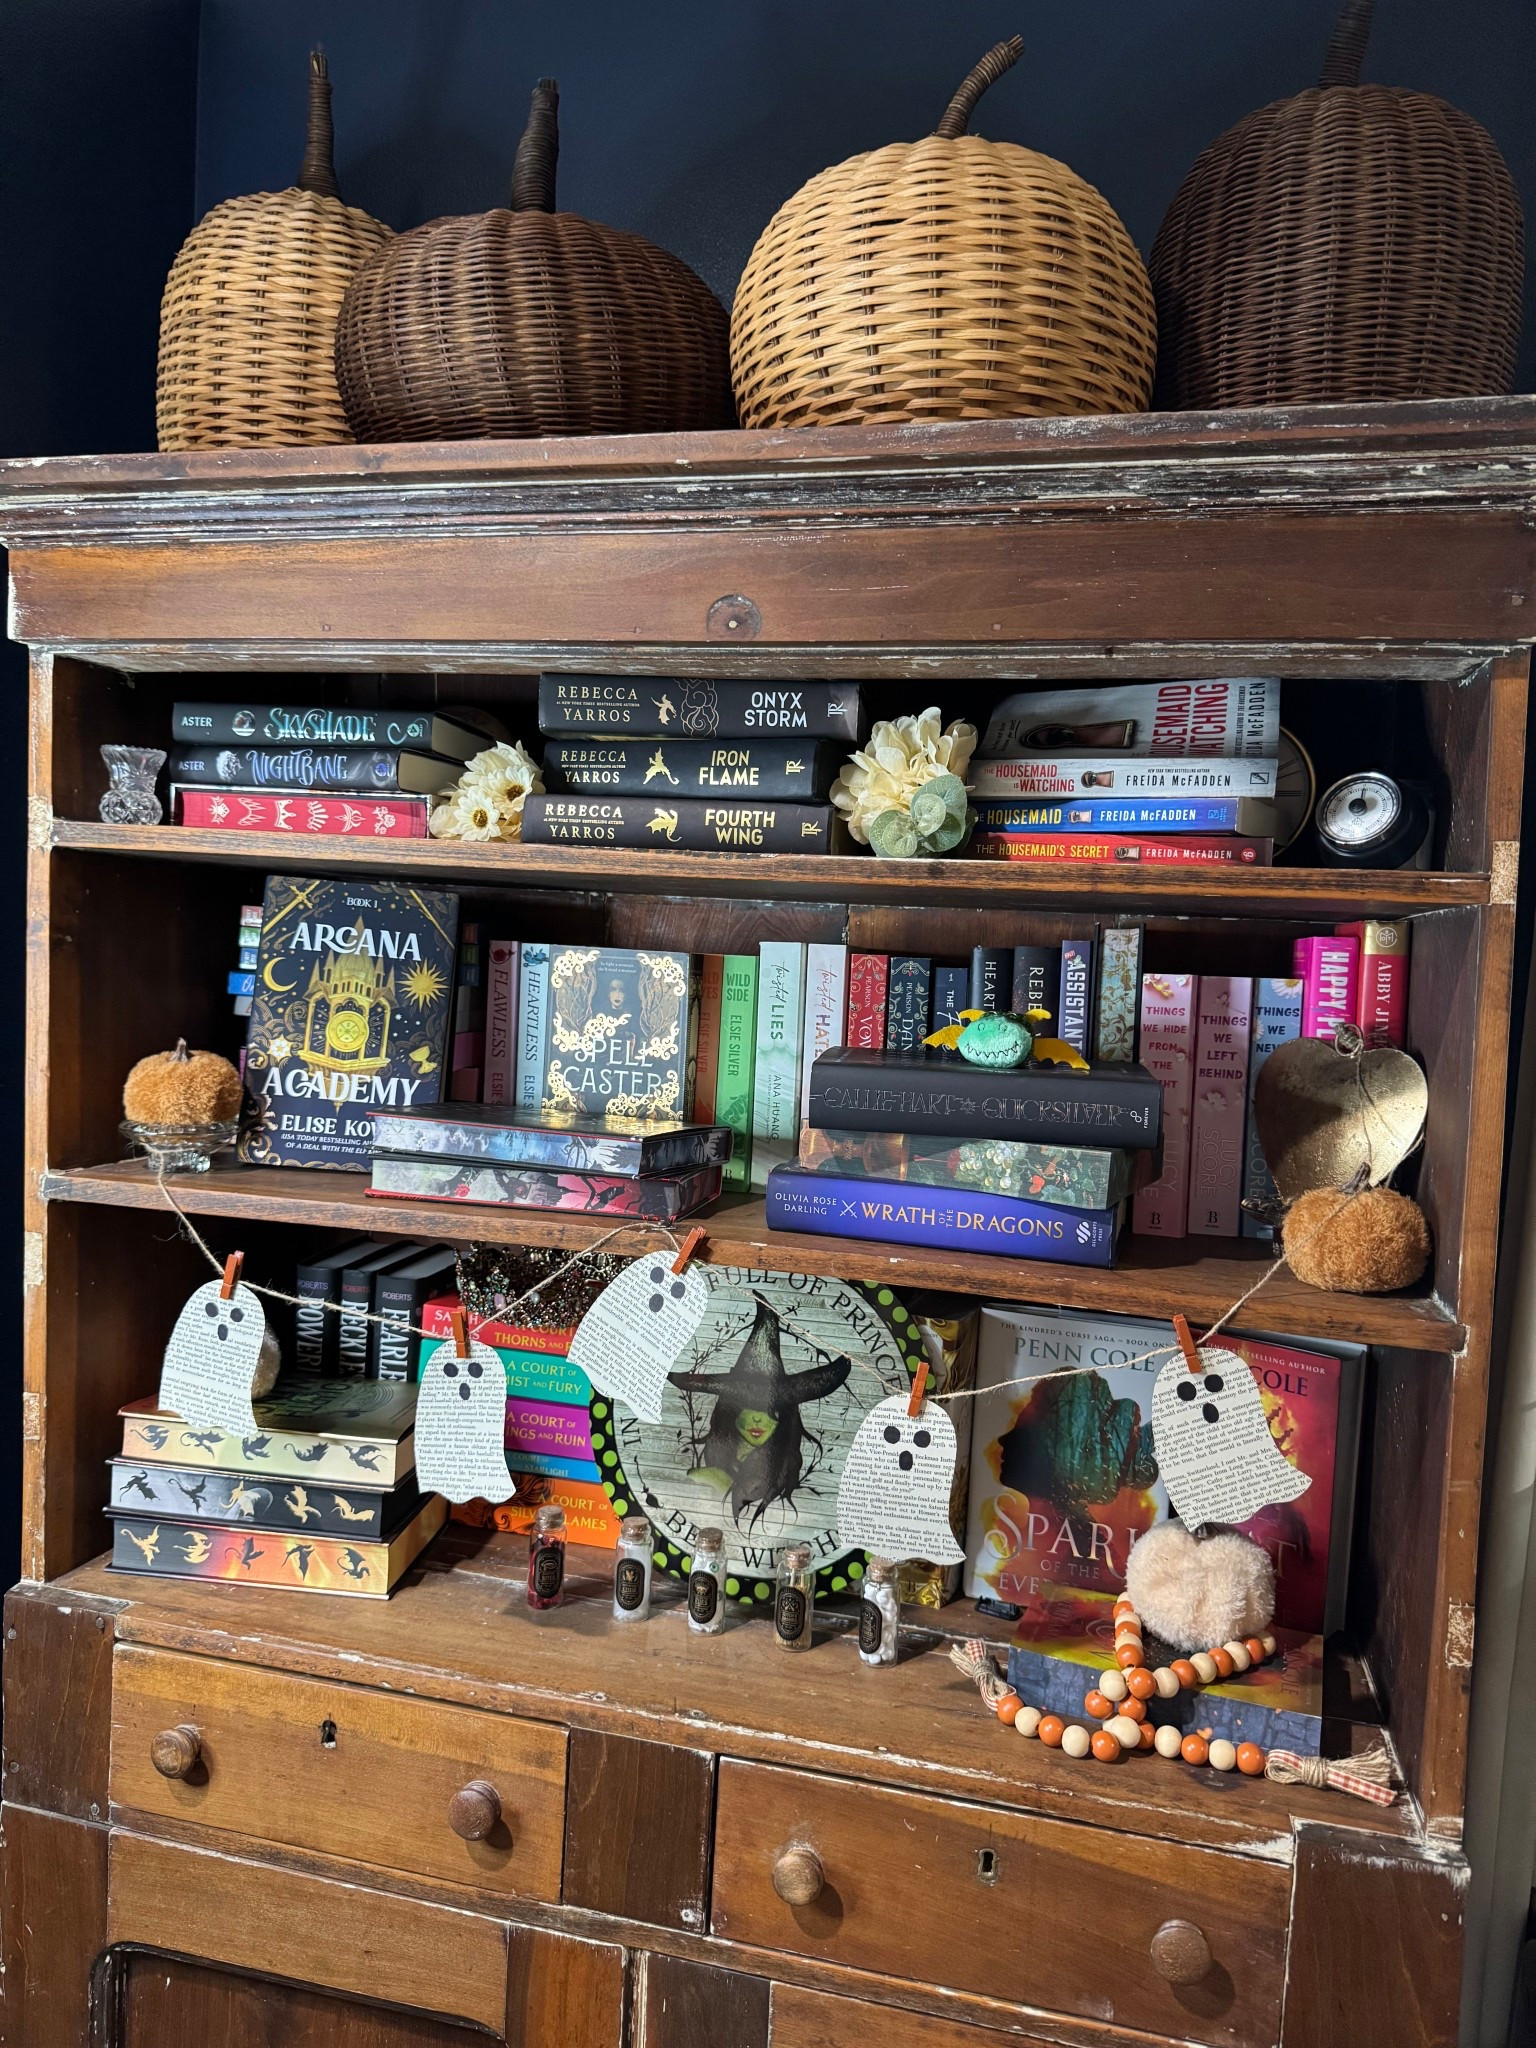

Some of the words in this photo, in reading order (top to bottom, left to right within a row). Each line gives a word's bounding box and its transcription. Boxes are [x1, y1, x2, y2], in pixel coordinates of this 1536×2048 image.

[557, 684, 639, 701] REBECCA
[751, 691, 803, 710] ONYX
[563, 708, 631, 723] YARROS
[744, 708, 807, 728] STORM
[1246, 682, 1266, 737] McFADDEN
[181, 715, 213, 728] ASTER
[1149, 685, 1192, 756] OUSEMAID
[560, 750, 627, 762] REBECCA
[711, 749, 750, 766] IRON
[178, 759, 205, 773] ASTER
[246, 748, 348, 786] NIGHTBANE
[995, 763, 1057, 778] HOUSEMAID
[565, 771, 620, 784] YARROS
[699, 767, 759, 786] FLAME
[1019, 778, 1075, 793] WATCHING
[1126, 774, 1165, 787] FREIDA
[1172, 774, 1231, 787] McFADDEN
[544, 803, 623, 818] REBECCA
[704, 808, 776, 828] FOURTH
[986, 809, 1062, 825] HOUSEMAID
[1100, 809, 1136, 822] FREIDA
[1140, 809, 1196, 822] McFADDEN
[549, 824, 616, 840] YARROS
[715, 827, 763, 846] WING
[975, 844, 995, 854] THE
[998, 843, 1065, 857] HOUSEMAID'S
[1070, 845, 1110, 858] SECRET
[1146, 848, 1177, 858] FREIDA
[1182, 848, 1232, 860] McFADDEN
[346, 896, 369, 908] BOOK
[288, 921, 421, 962] ARCANA
[726, 972, 751, 988] WILD
[1318, 951, 1350, 1011] HAPPY
[1376, 960, 1393, 1004] ABBY
[726, 988, 749, 1003] SIDE
[905, 981, 913, 1014] PEARSON
[946, 989, 955, 1008] THE
[491, 969, 509, 1058] FLAWLESS
[525, 970, 541, 1061] HEARTLESS
[1065, 959, 1086, 1057] ASSISTANT
[1145, 1005, 1186, 1017] THINGS
[1255, 1005, 1300, 1017] THINGS
[730, 1014, 742, 1043] ELSIE
[770, 1003, 785, 1041] LIES
[1143, 1023, 1159, 1032] WE
[1163, 1024, 1187, 1034] HIDE
[1201, 1014, 1248, 1027] THINGS
[1213, 1033, 1233, 1043] WE
[1267, 1025, 1285, 1035] WE
[571, 1037, 654, 1069] SPELL
[1148, 1041, 1177, 1051] FROM
[727, 1044, 741, 1077] SILVER
[1207, 1050, 1237, 1061] LEFT
[1152, 1060, 1173, 1070] THE
[1198, 1068, 1243, 1080] BEHIND
[261, 1067, 421, 1107] ACADEMY
[491, 1072, 504, 1098] ELSIE
[524, 1075, 536, 1100] ELSIE
[562, 1066, 662, 1098] CASTER
[773, 1074, 782, 1099] ANA
[823, 1085, 893, 1112] CALLIE
[898, 1091, 961, 1115] HART
[981, 1097, 1124, 1127] QUICKSILVER
[280, 1114, 338, 1135] ELISE
[771, 1101, 781, 1141] HUANG
[296, 1134, 318, 1142] TODAY
[318, 1136, 361, 1145] BESTSELLING
[303, 1143, 320, 1151] DEAL
[322, 1145, 340, 1153] WITH
[1200, 1129, 1219, 1197] SCORE
[1219, 1139, 1237, 1191] LUCY
[775, 1192, 810, 1203] OLIVIA
[813, 1196, 837, 1206] ROSE
[784, 1203, 827, 1216] DARLING
[860, 1202, 935, 1226] WRATH
[938, 1212, 946, 1224] OF
[946, 1208, 954, 1228] THE
[956, 1211, 1064, 1240] DRAGONS
[297, 1280, 329, 1290] ROBERTS
[342, 1284, 369, 1293] ROBERTS
[706, 1265, 778, 1295] FULL
[787, 1272, 828, 1299] OF
[381, 1291, 413, 1301] ROBERTS
[435, 1309, 478, 1326] SAH
[494, 1331, 547, 1349] THORNS
[549, 1341, 563, 1349] AND
[999, 1322, 1016, 1330] THE
[1019, 1325, 1062, 1336] KINDRED'S
[1065, 1330, 1091, 1340] CURSE
[1094, 1335, 1115, 1343] SAGA
[1126, 1339, 1149, 1347] BOOK
[1013, 1336, 1082, 1363] PENN
[1090, 1346, 1156, 1373] COLE
[507, 1359, 516, 1371] A
[521, 1362, 566, 1378] COURT
[1288, 1361, 1327, 1375] AUTHOR
[532, 1380, 547, 1388] AND
[548, 1380, 582, 1395] FURY
[1249, 1364, 1308, 1397] COLE
[506, 1411, 516, 1422] A
[520, 1412, 566, 1429] COURT
[506, 1425, 536, 1440] INGS
[538, 1432, 554, 1440] AND
[554, 1432, 586, 1448] RUIN
[524, 1464, 569, 1477] STARLIGHT
[537, 1493, 546, 1502] A
[550, 1494, 596, 1511] COURT
[564, 1513, 608, 1530] LAMES
[664, 1510, 698, 1547] BE
[742, 1529, 843, 1570] WIH
[1040, 1559, 1061, 1574] OF
[1067, 1562, 1100, 1579] THE
